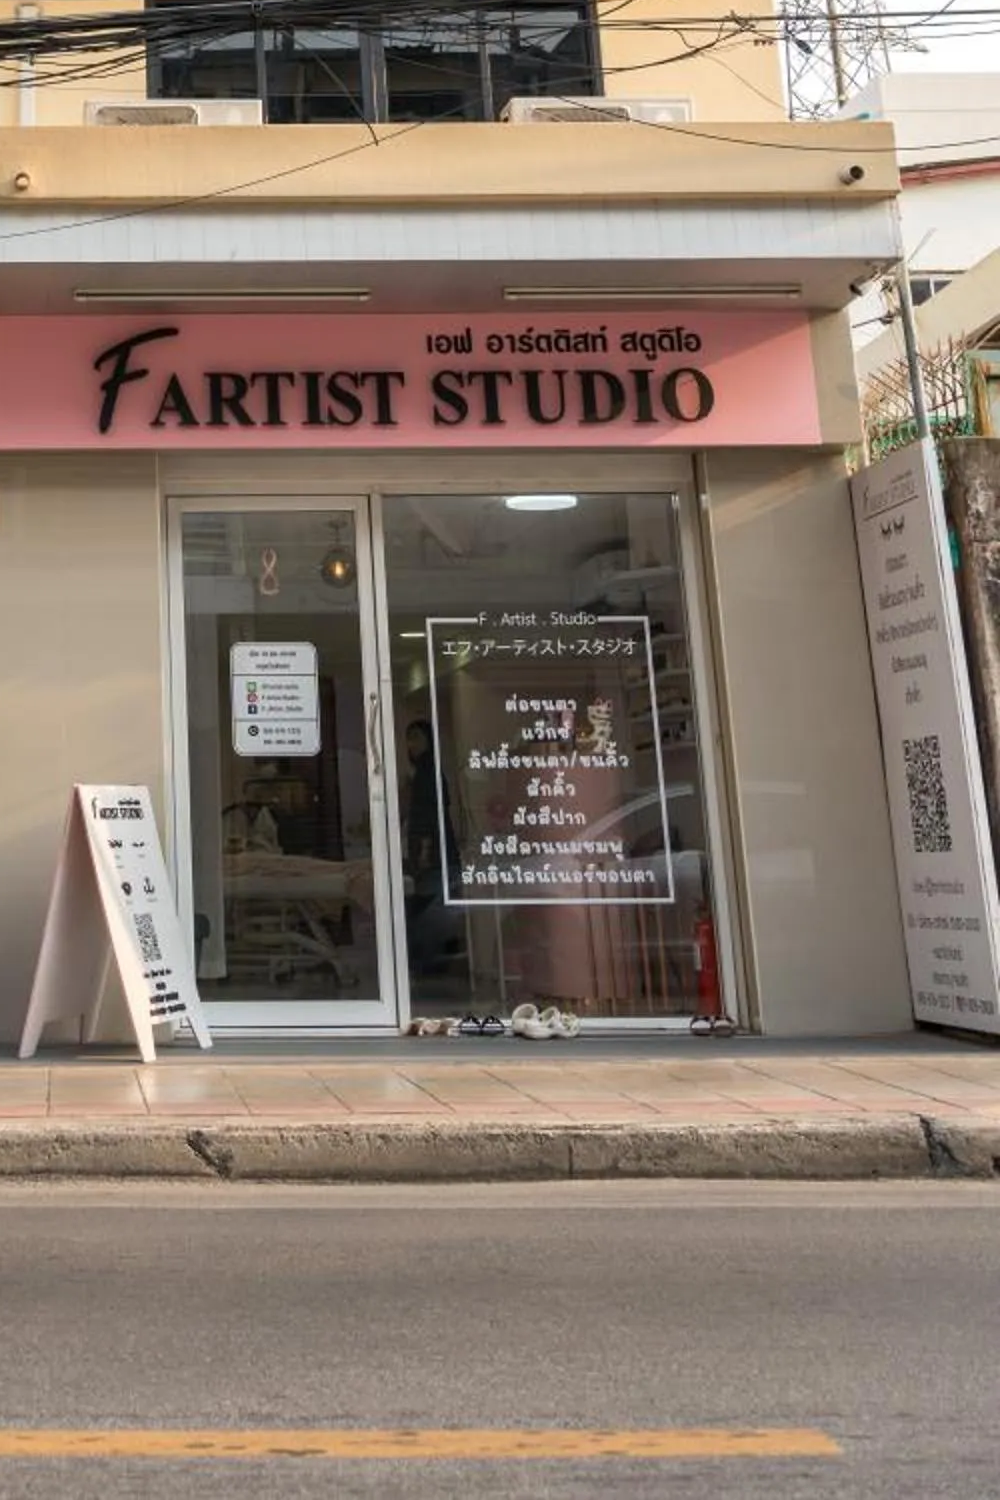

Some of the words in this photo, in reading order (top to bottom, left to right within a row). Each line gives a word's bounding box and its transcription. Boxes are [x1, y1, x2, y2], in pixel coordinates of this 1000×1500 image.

[426, 327, 472, 354] เอฟ
[620, 326, 702, 361] สตูดิโอ
[432, 367, 716, 426] STUDIO
[478, 611, 488, 626] F
[500, 611, 537, 627] Artist
[550, 610, 597, 626] Studio
